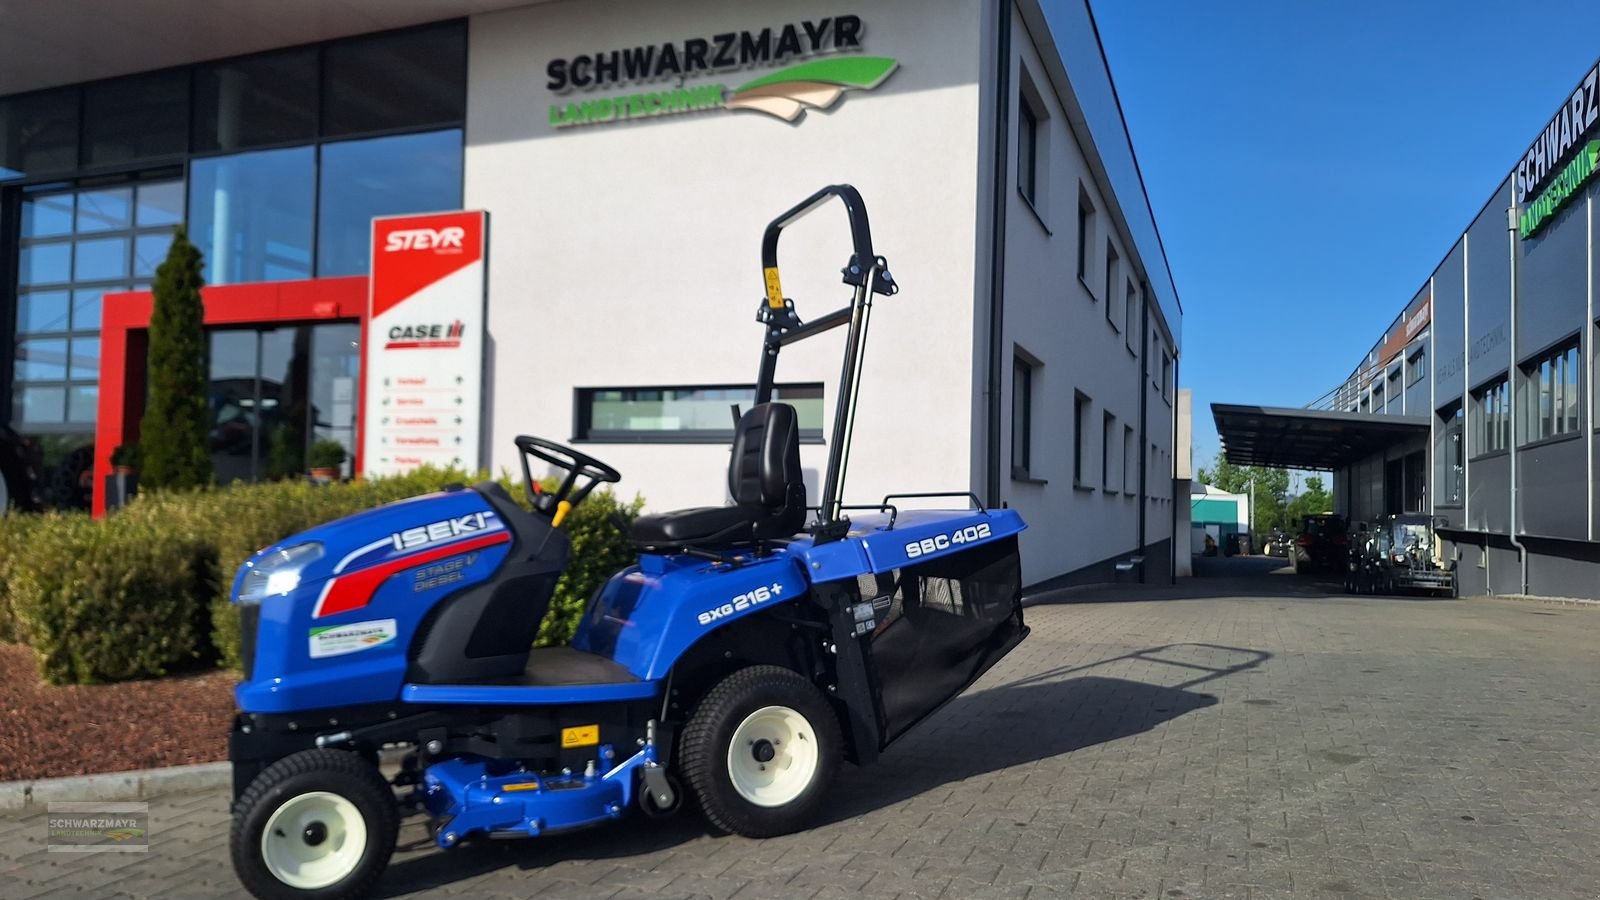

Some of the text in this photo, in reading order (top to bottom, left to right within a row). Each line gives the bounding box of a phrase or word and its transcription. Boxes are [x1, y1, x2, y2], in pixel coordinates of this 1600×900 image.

[546, 14, 862, 91] SCHWARZMAYR
[549, 84, 725, 127] LANDTECHNIK
[1517, 62, 1600, 203] SCHWARZ
[384, 226, 465, 252] STEYR
[389, 324, 442, 340] CASE
[392, 511, 487, 551] ISEKI
[905, 522, 991, 558] SBC 402
